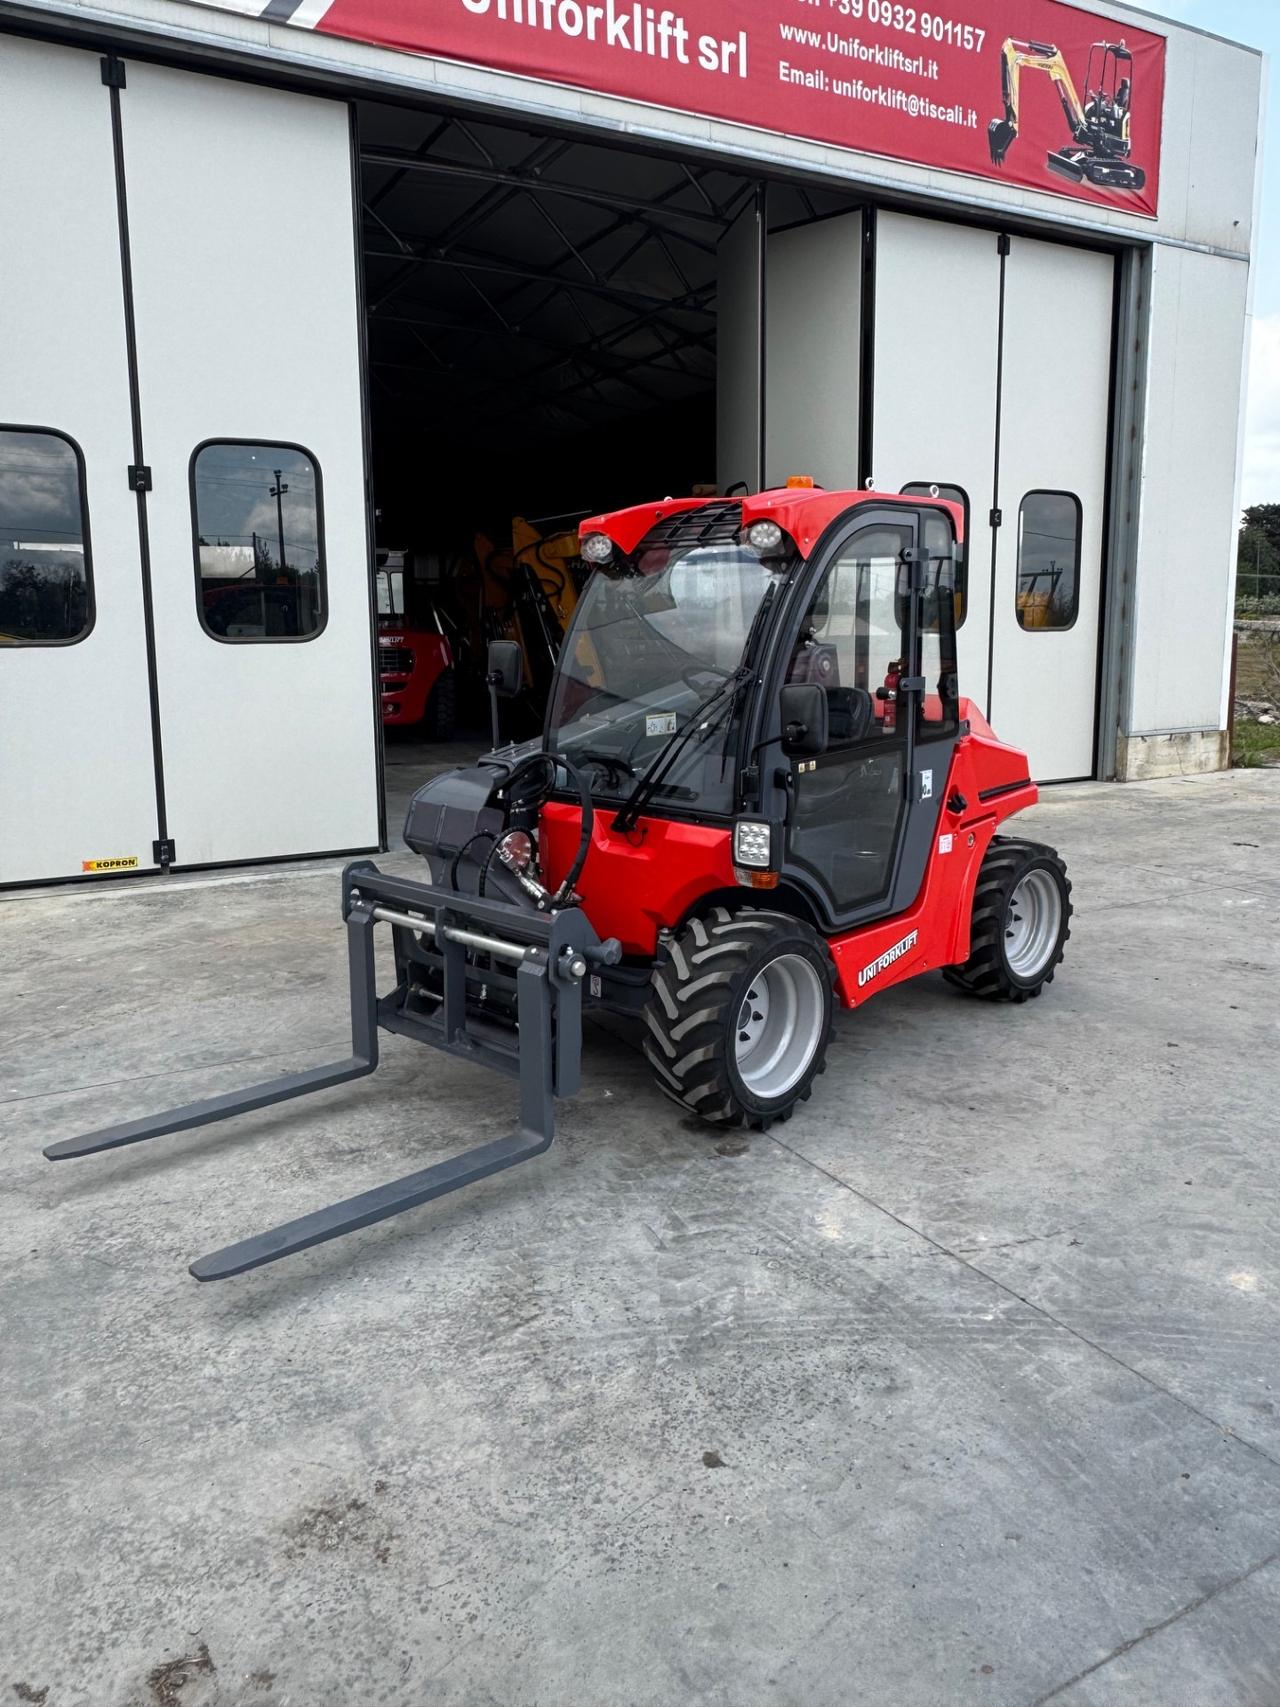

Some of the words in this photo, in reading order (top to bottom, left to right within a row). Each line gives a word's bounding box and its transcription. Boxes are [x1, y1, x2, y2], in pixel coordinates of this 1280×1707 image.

[461, 0, 690, 65] niforklift
[698, 31, 748, 79] srl
[779, 23, 939, 80] www.Uniforkliftsrl.it
[867, 0, 916, 34] 0932
[920, 12, 986, 53] 901157
[779, 60, 829, 92] Email:
[832, 79, 978, 129] uniforklift@tiscali.it
[96, 860, 135, 868] KOPRON
